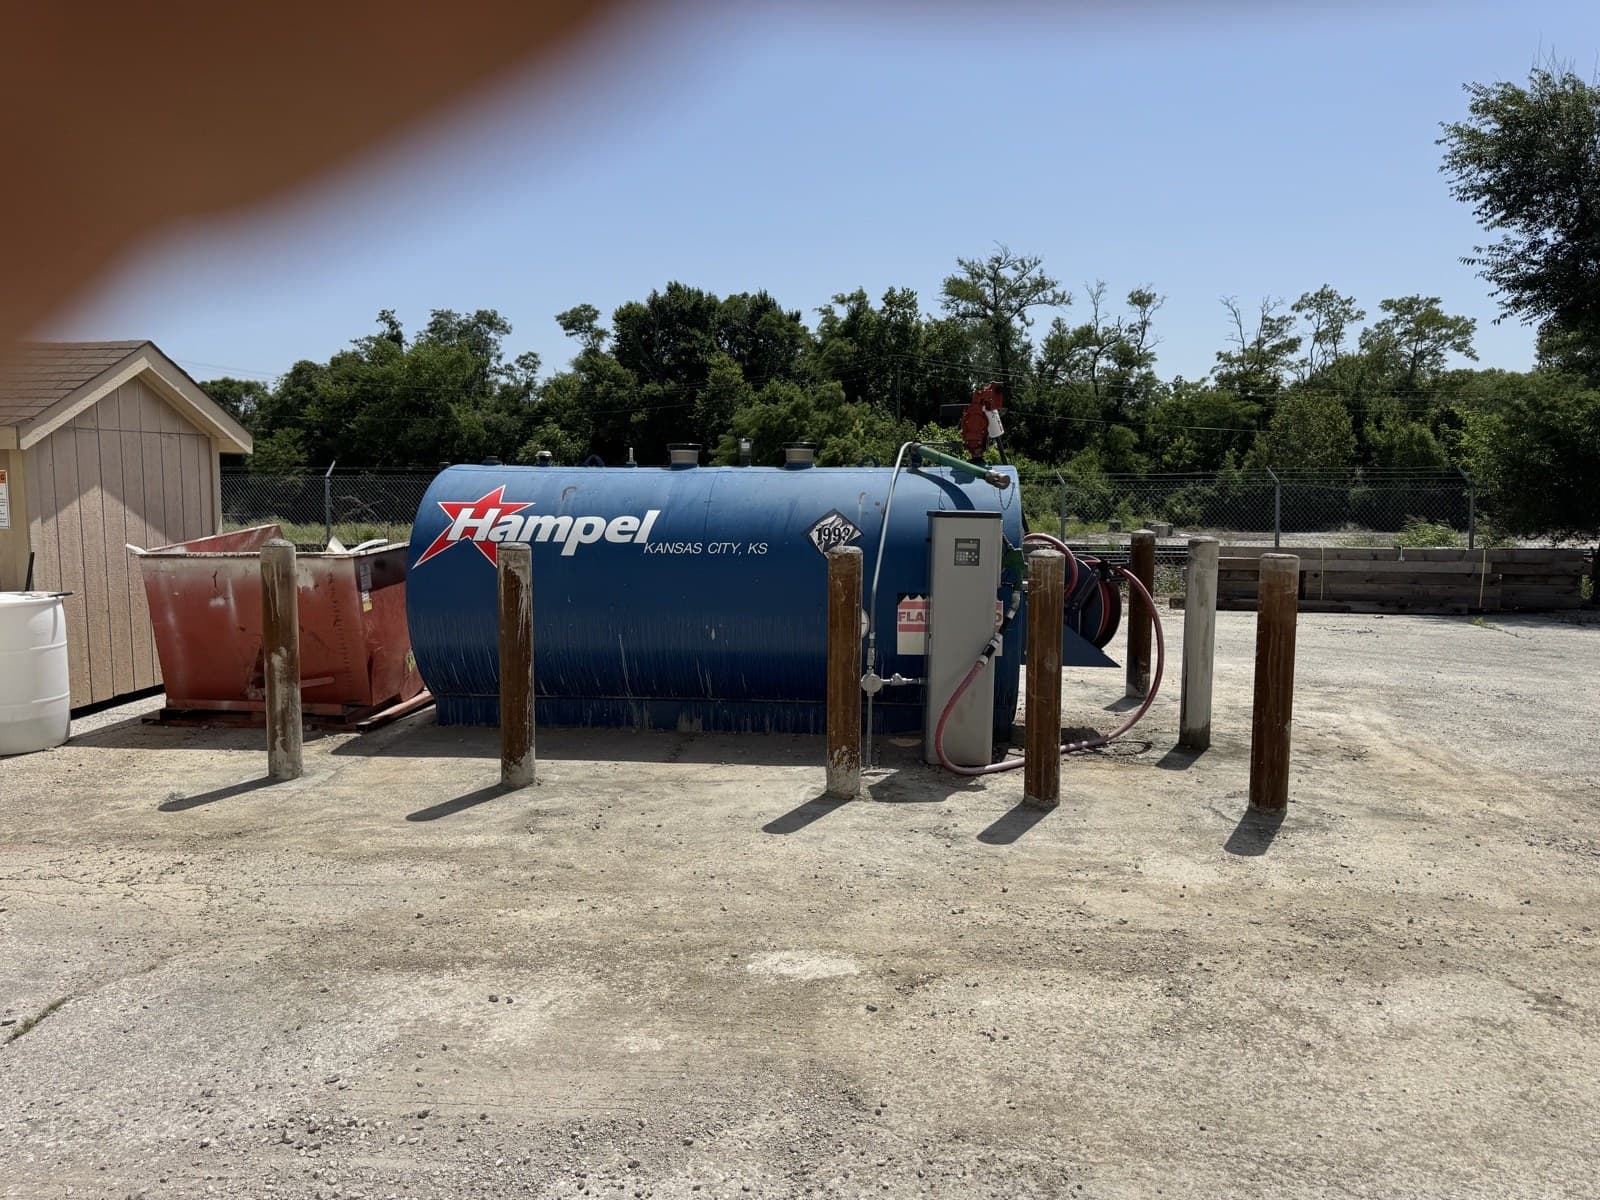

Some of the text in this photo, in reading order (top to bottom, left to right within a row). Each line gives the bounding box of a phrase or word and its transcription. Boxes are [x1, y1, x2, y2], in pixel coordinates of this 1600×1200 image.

[446, 508, 661, 556] Hampel
[643, 542, 768, 555] KANSAS CITY, KS
